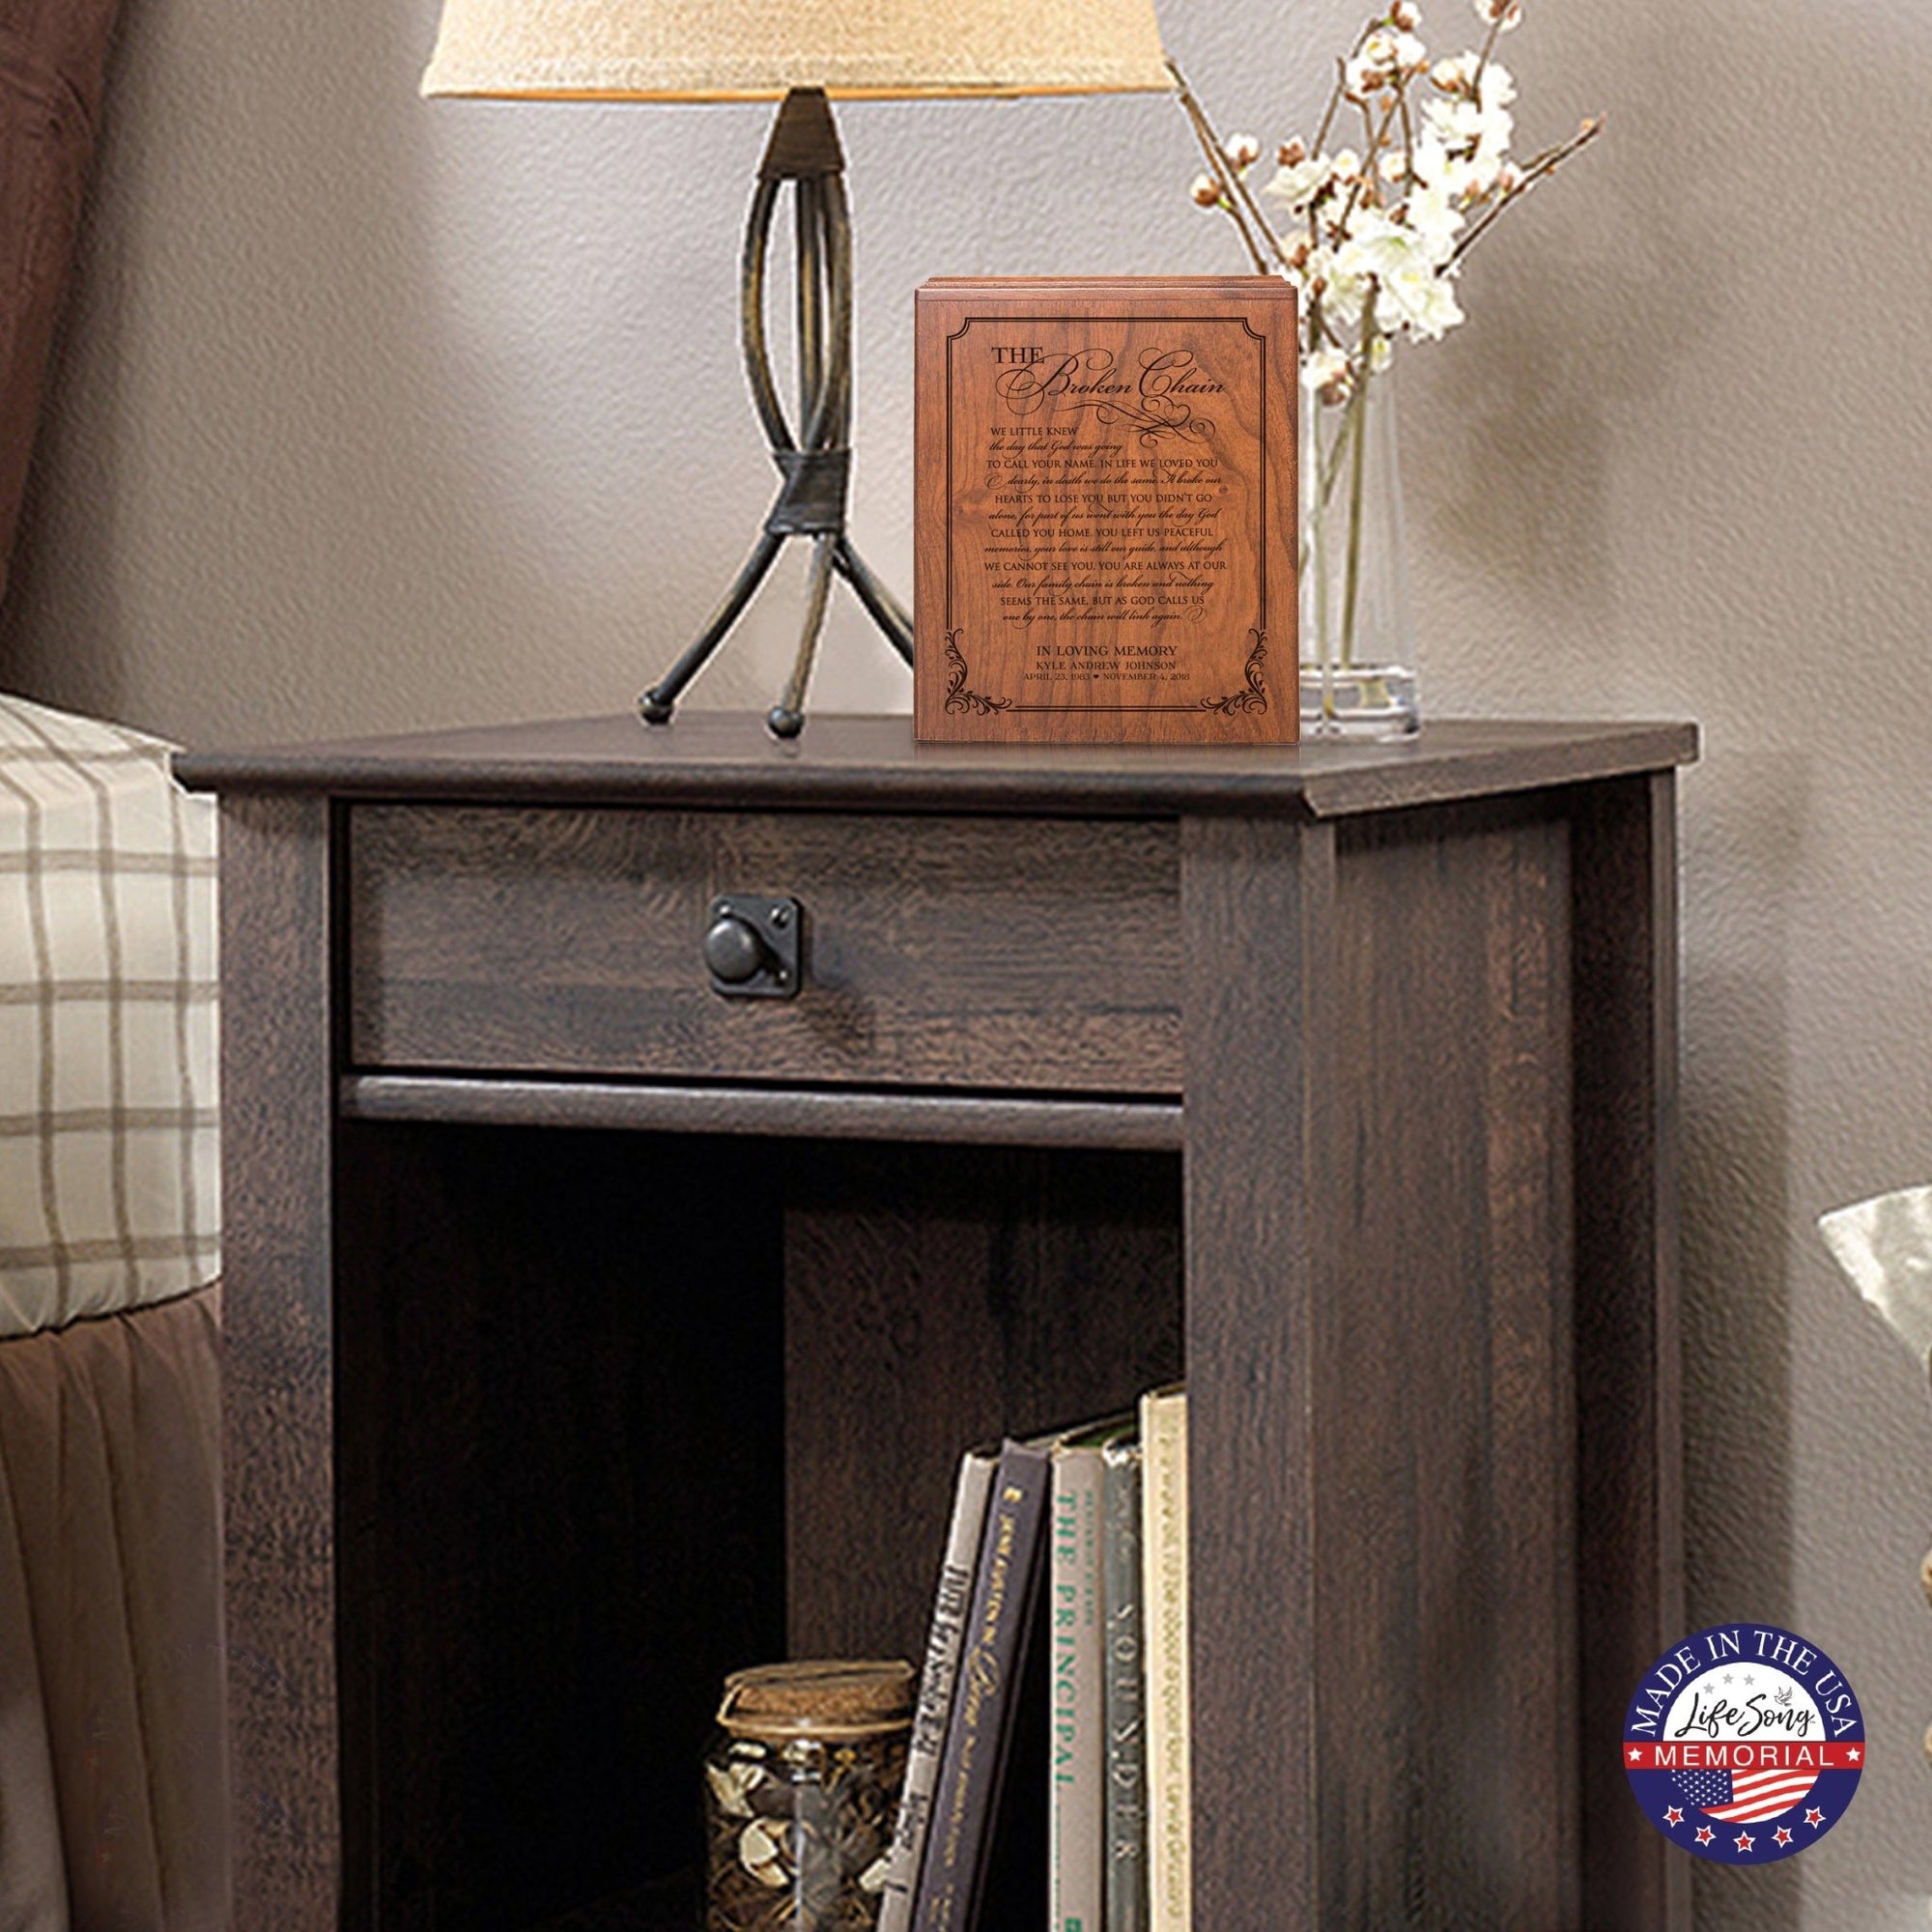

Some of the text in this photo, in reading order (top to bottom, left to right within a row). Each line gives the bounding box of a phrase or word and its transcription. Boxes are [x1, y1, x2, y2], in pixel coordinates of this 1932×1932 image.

[991, 347, 1044, 364] THE
[1139, 347, 1225, 398] Chain
[990, 427, 1079, 436] WE LITTLE KNEW
[989, 438, 1005, 450] the
[1002, 440, 1025, 459] day
[1027, 438, 1048, 450] that
[1047, 440, 1075, 458] God
[1088, 444, 1122, 458] going
[986, 459, 1001, 469] TO
[1005, 459, 1030, 469] CALL
[1032, 459, 1061, 469] YOUR
[1101, 459, 1113, 469] IN
[1117, 459, 1137, 469] LIFE
[1140, 459, 1155, 469] WE
[1159, 459, 1193, 469] LOVED
[1196, 459, 1218, 469] YOU
[1056, 471, 1087, 484] death
[1098, 474, 1112, 484] do
[1113, 471, 1129, 484] the
[1179, 470, 1203, 484] broke
[995, 493, 1213, 502] HEARTS TO LOSE YOU BUT YOU DIDN'T GO
[1015, 506, 1035, 526] for
[1032, 511, 1060, 526] part
[1060, 506, 1078, 526] of
[1112, 505, 1140, 519] with
[1135, 513, 1156, 526] you
[1158, 505, 1175, 519] the
[1172, 508, 1195, 527] day
[1194, 507, 1222, 526] God
[990, 528, 1030, 537] CALLED
[1033, 528, 1055, 537] YOU
[1095, 528, 1118, 537] YOU
[1122, 528, 1144, 537] LEFT
[1147, 528, 1160, 537] US
[1164, 528, 1213, 537] PEACEFUL
[1058, 542, 1078, 553] love
[1090, 541, 1113, 553] still
[1159, 541, 1182, 553] and
[1179, 538, 1227, 559] although
[984, 562, 1000, 571] WE
[1003, 562, 1048, 571] CANNOT
[1051, 562, 1067, 571] SEE
[1098, 562, 1121, 571] YOU
[1123, 562, 1143, 571] ARE
[1146, 562, 1184, 571] ALWAYS
[1187, 562, 1201, 571] AT
[1203, 562, 1227, 571] OUR
[1015, 578, 1036, 588] Our
[1033, 575, 1072, 596] family
[1073, 575, 1102, 588] chain
[1116, 575, 1151, 588] broken
[1173, 574, 1214, 596] nothing
[1000, 596, 1032, 605] SEEMS
[1035, 596, 1056, 605] THE
[1093, 596, 1112, 605] BUT
[1115, 596, 1127, 605] AS
[1130, 596, 1155, 605] GOD
[1158, 596, 1188, 605] CALLS
[1191, 596, 1205, 605] US
[1059, 608, 1075, 620] the
[1076, 608, 1104, 620] chain
[1106, 610, 1130, 620] will
[1128, 607, 1155, 620] link
[1037, 646, 1178, 656] IN LOVING MEMORY
[1057, 1491, 1077, 1565] THE
[1056, 1585, 1076, 1783] PRINCIPAL
[1112, 1604, 1140, 1861] SOUNDER
